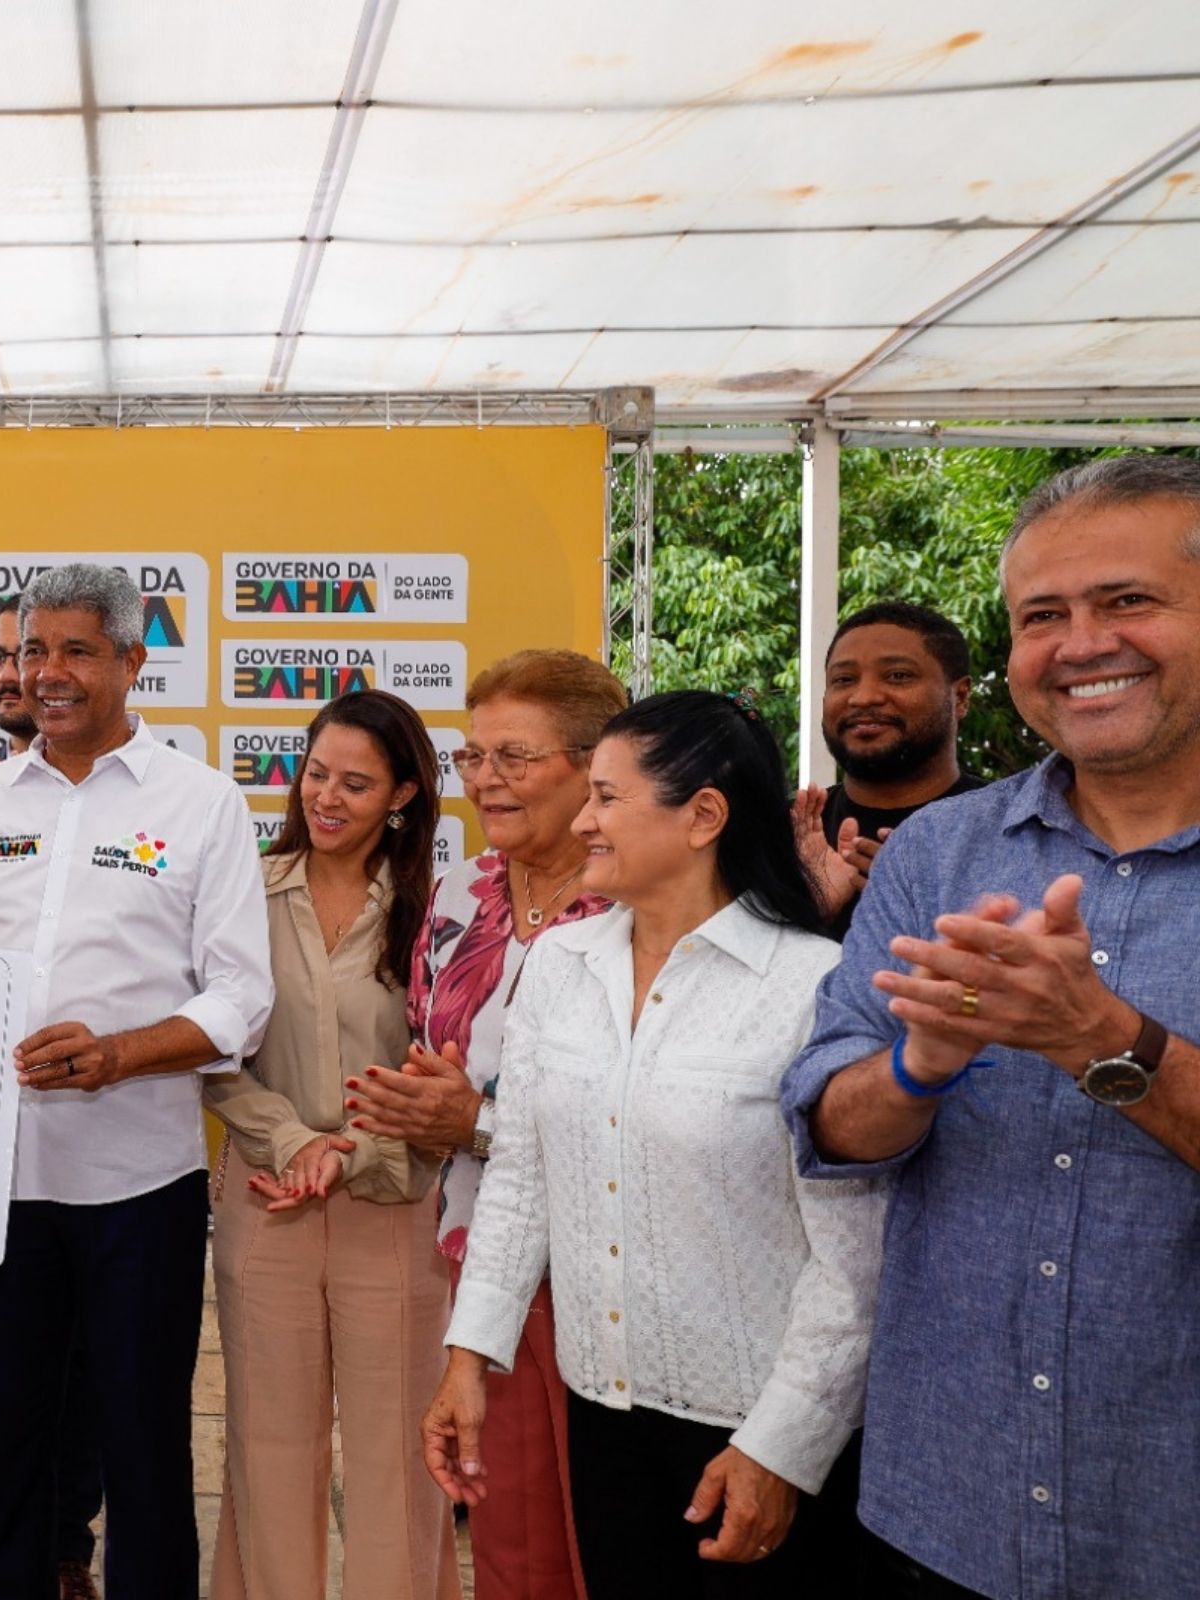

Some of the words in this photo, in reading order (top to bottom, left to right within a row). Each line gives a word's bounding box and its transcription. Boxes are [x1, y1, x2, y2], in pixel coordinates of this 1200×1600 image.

[236, 562, 340, 578] GOVERNO
[348, 562, 376, 578] DA
[141, 566, 185, 592] DA
[395, 576, 413, 586] DO
[417, 577, 451, 587] LADO
[235, 580, 376, 612] BAHIA
[394, 590, 411, 600] DA
[414, 590, 454, 600] GENTE
[235, 648, 338, 665] GOVERNO
[347, 649, 375, 665] DA
[393, 664, 412, 674] DO
[415, 664, 450, 674] LADO
[127, 677, 166, 692] NTE
[393, 677, 410, 687] DA
[412, 677, 452, 687] GENTE
[234, 735, 305, 751] GOVER
[94, 845, 130, 859] SAÚDE
[91, 857, 119, 869] MAIS
